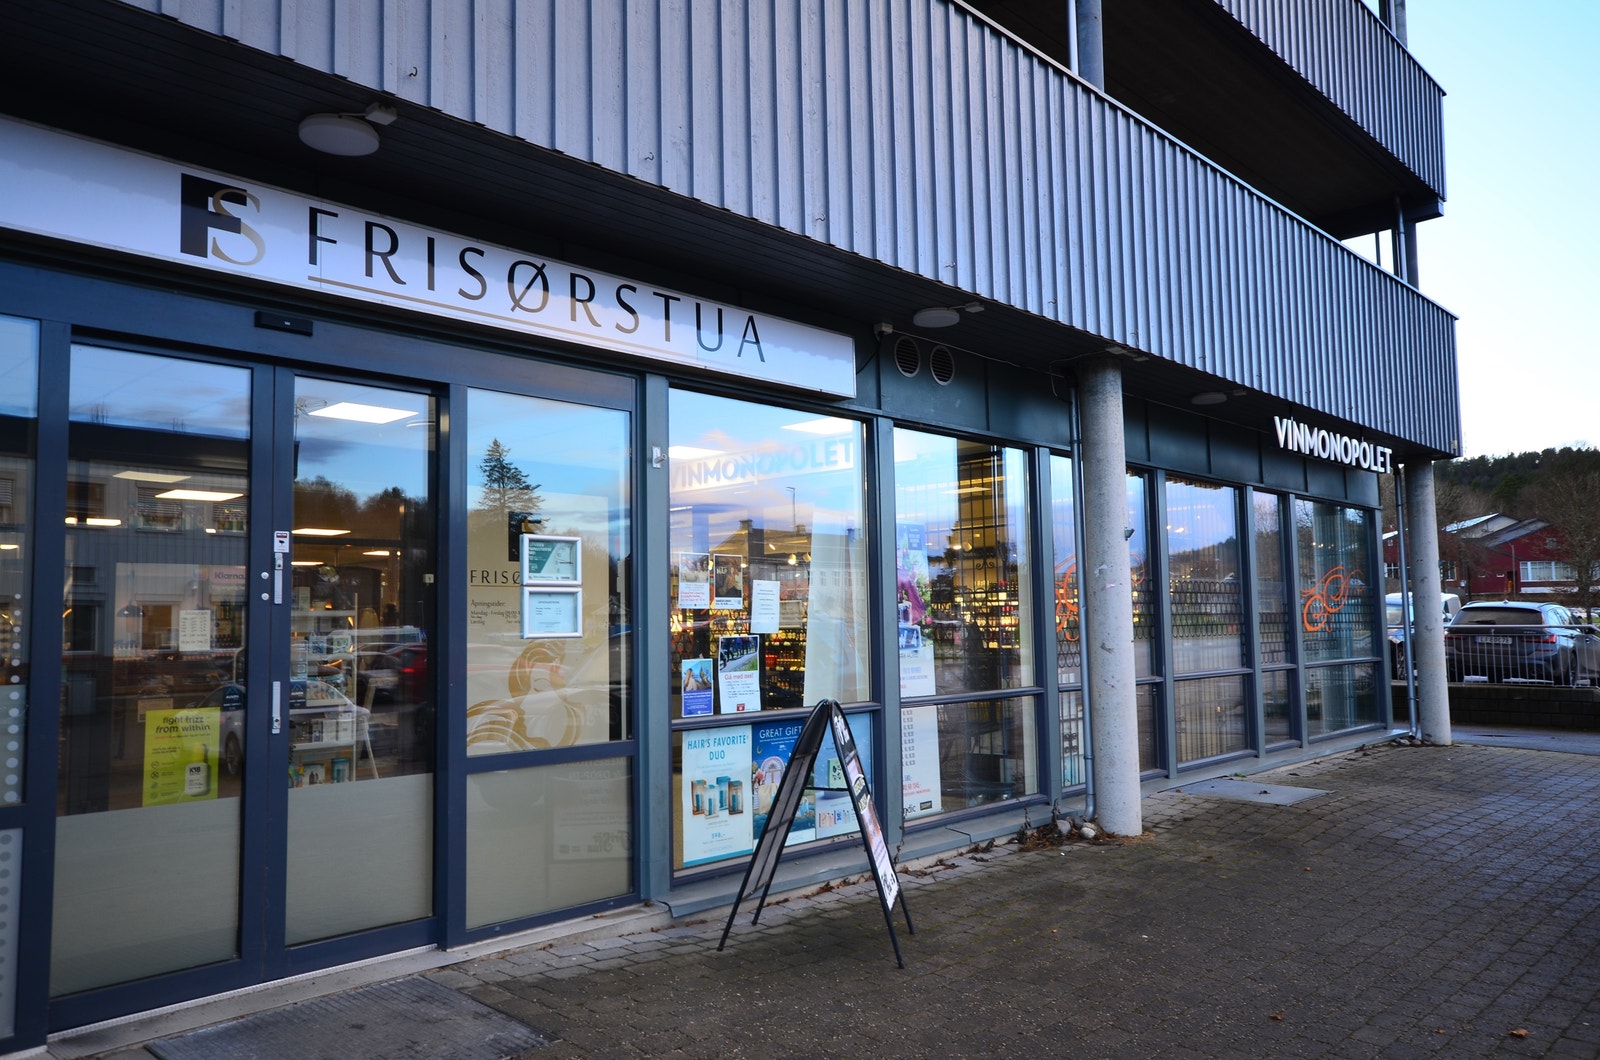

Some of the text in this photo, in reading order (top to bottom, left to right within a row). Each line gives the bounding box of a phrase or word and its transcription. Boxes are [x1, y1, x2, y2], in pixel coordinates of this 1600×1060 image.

[309, 206, 766, 363] FRISØRSTUA
[1273, 415, 1392, 474] VINMONOPOLET
[185, 715, 204, 724] frizz
[155, 724, 211, 734] from within
[759, 727, 783, 739] GREAT
[687, 738, 711, 750] HAIR'S
[713, 734, 747, 747] FAVORITE
[709, 750, 726, 761] DUO
